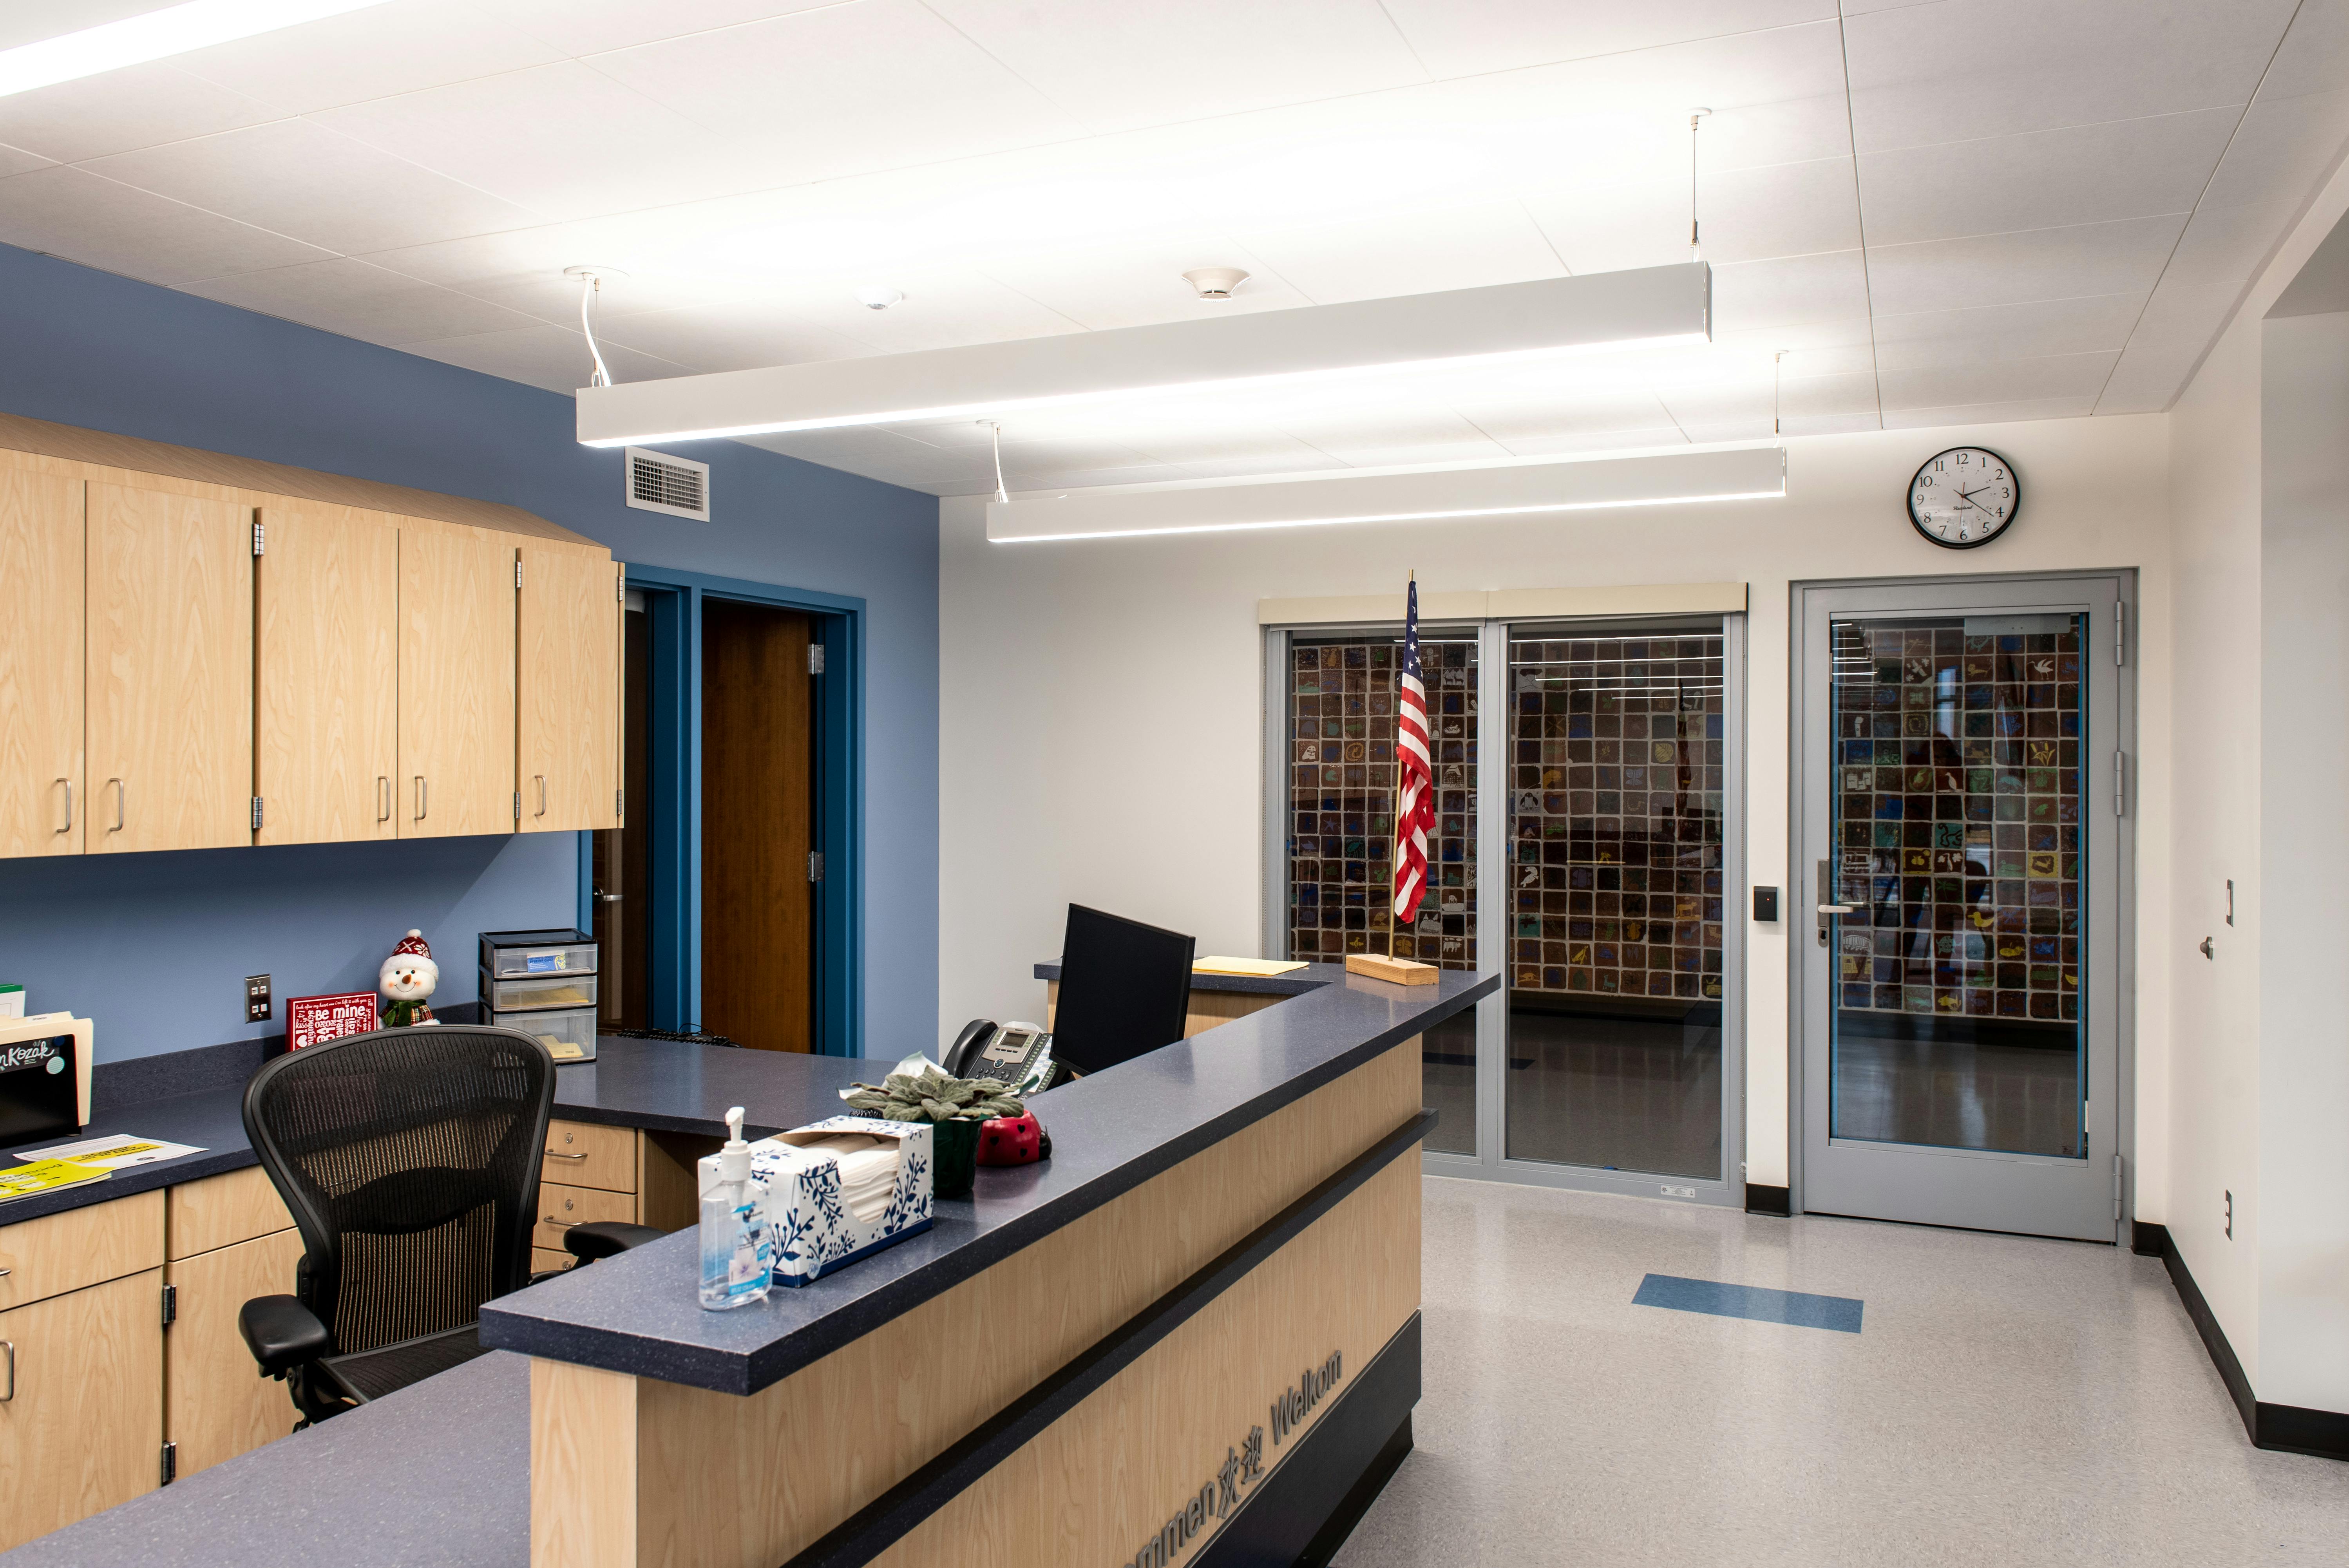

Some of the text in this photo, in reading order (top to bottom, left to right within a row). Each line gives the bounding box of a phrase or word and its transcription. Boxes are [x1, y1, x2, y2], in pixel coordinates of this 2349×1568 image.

[1956, 453, 1969, 465] 12
[1982, 457, 1986, 468] 1
[1935, 460, 1944, 471] 11
[1995, 469, 2004, 480] 2
[1920, 476, 1933, 487] 10
[2002, 487, 2009, 498] 3
[1916, 494, 1924, 505] 9
[1995, 506, 2004, 517] 4
[1924, 512, 1931, 523] 8
[1939, 525, 1947, 536] 7
[1982, 522, 1989, 533] 5
[1960, 530, 1968, 540] 6
[315, 1004, 365, 1021] Be mine
[295, 1019, 308, 1029] kiss
[348, 1018, 357, 1034] lips
[9, 1041, 55, 1066] Kozak
[1217, 1425, 1265, 1519] 欢迎
[1271, 1349, 1342, 1445] Welkom
